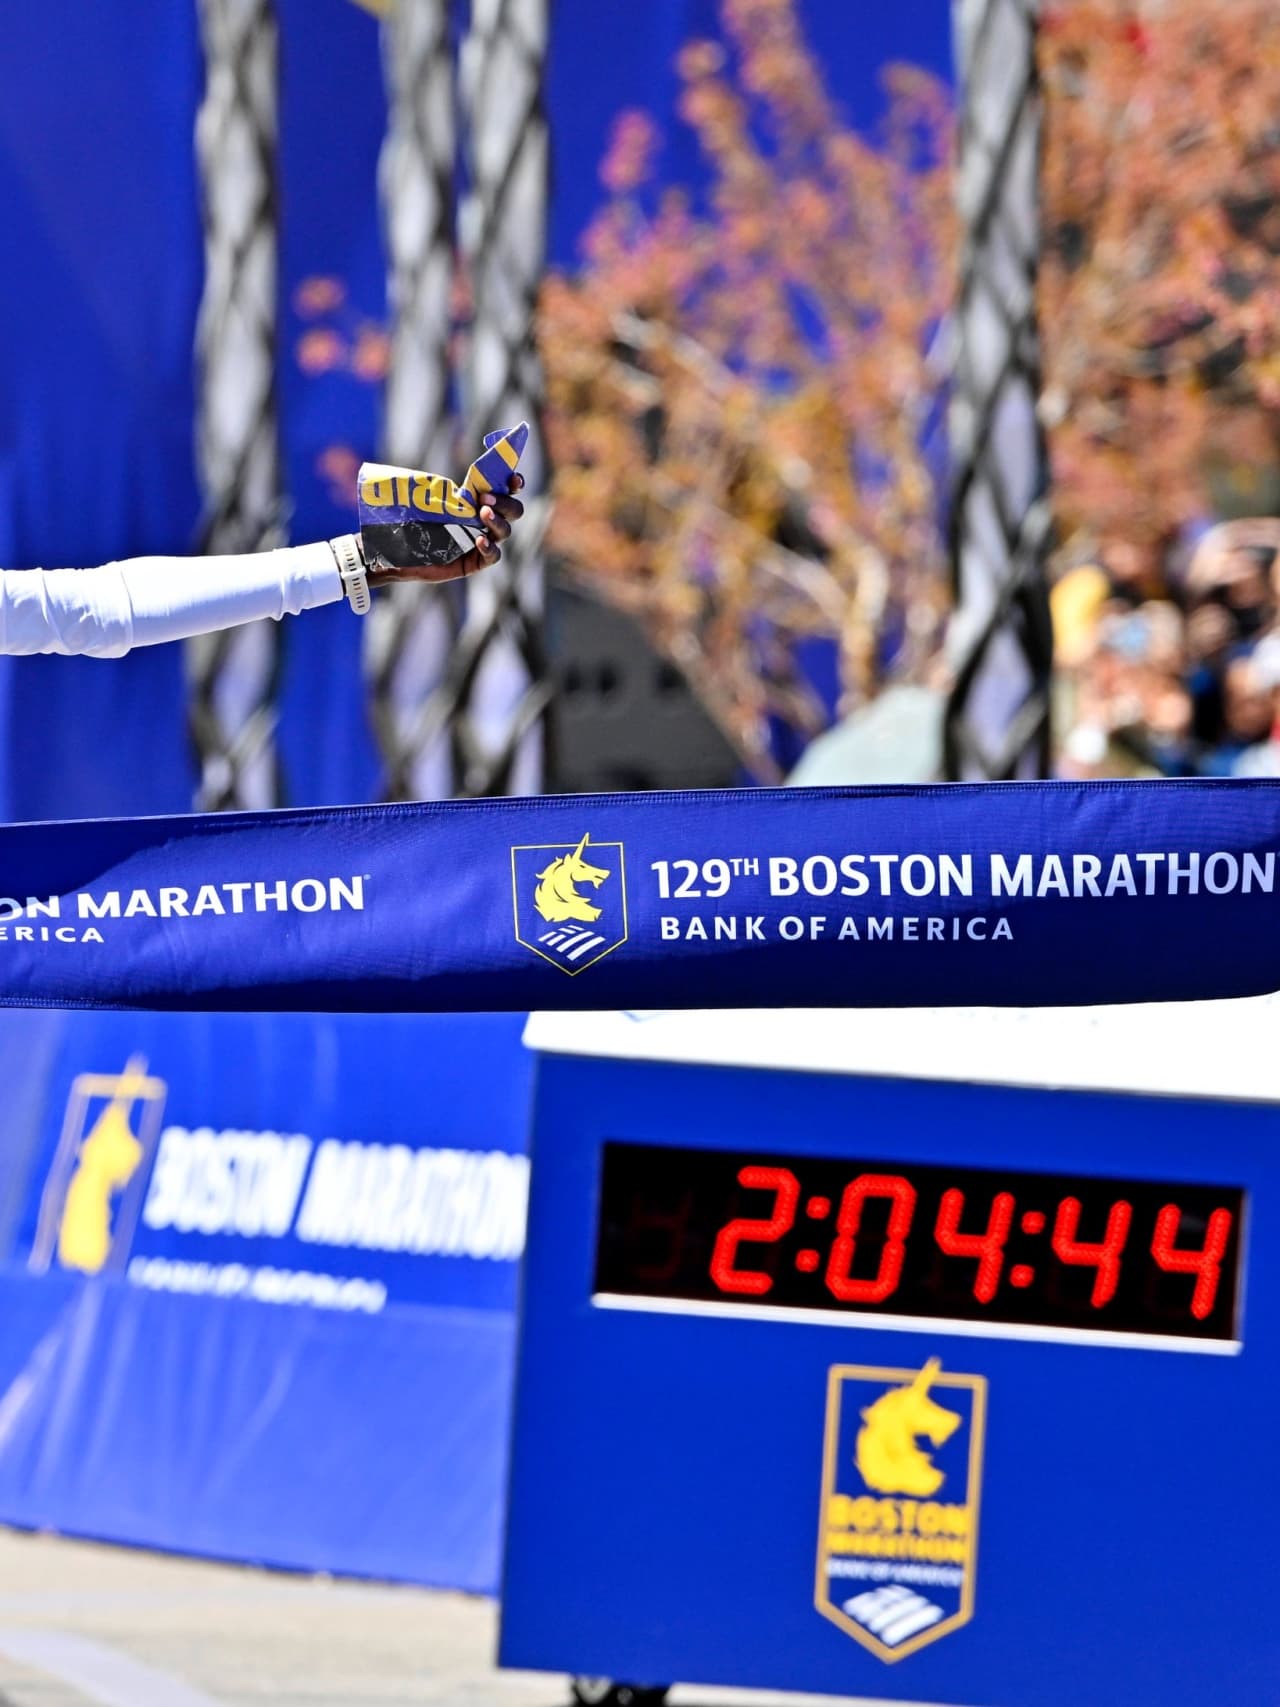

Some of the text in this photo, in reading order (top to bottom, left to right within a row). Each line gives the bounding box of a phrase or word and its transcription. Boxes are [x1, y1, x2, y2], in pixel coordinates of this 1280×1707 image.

[77, 876, 364, 918] MARATHON
[651, 852, 1276, 898] 129TH BOSTON MARATHON
[661, 916, 1014, 941] BANK OF AMERICA
[710, 1166, 1232, 1319] 2:04:44
